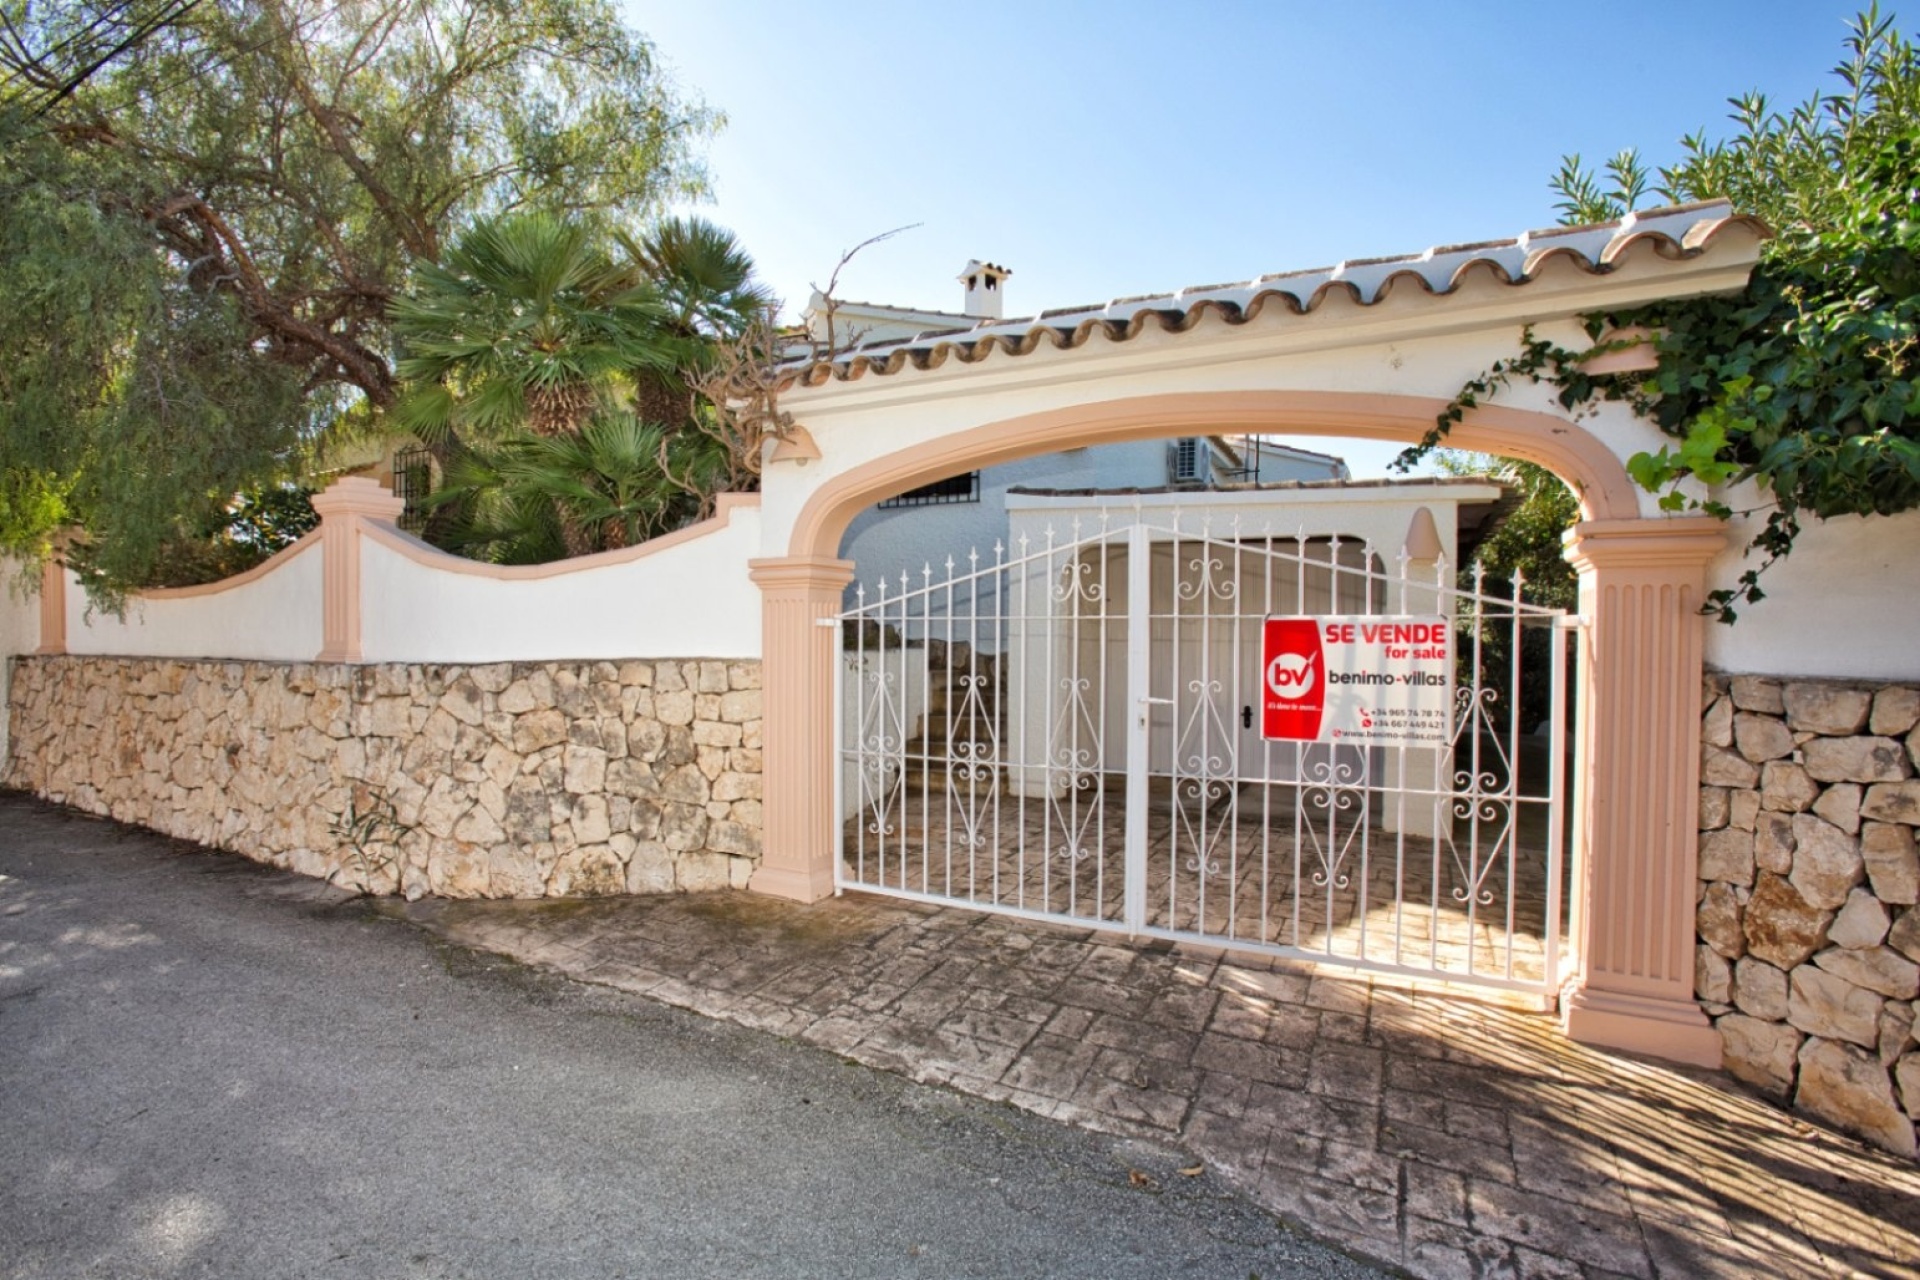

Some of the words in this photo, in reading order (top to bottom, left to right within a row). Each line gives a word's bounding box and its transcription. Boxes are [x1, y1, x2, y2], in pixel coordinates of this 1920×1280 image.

[1326, 624, 1355, 644] SE
[1361, 624, 1446, 644] VENDE
[1384, 645, 1408, 659] for
[1412, 646, 1446, 660] sale
[1329, 670, 1446, 686] benimo-villas
[1343, 730, 1446, 740] www.benimo-villas.com
